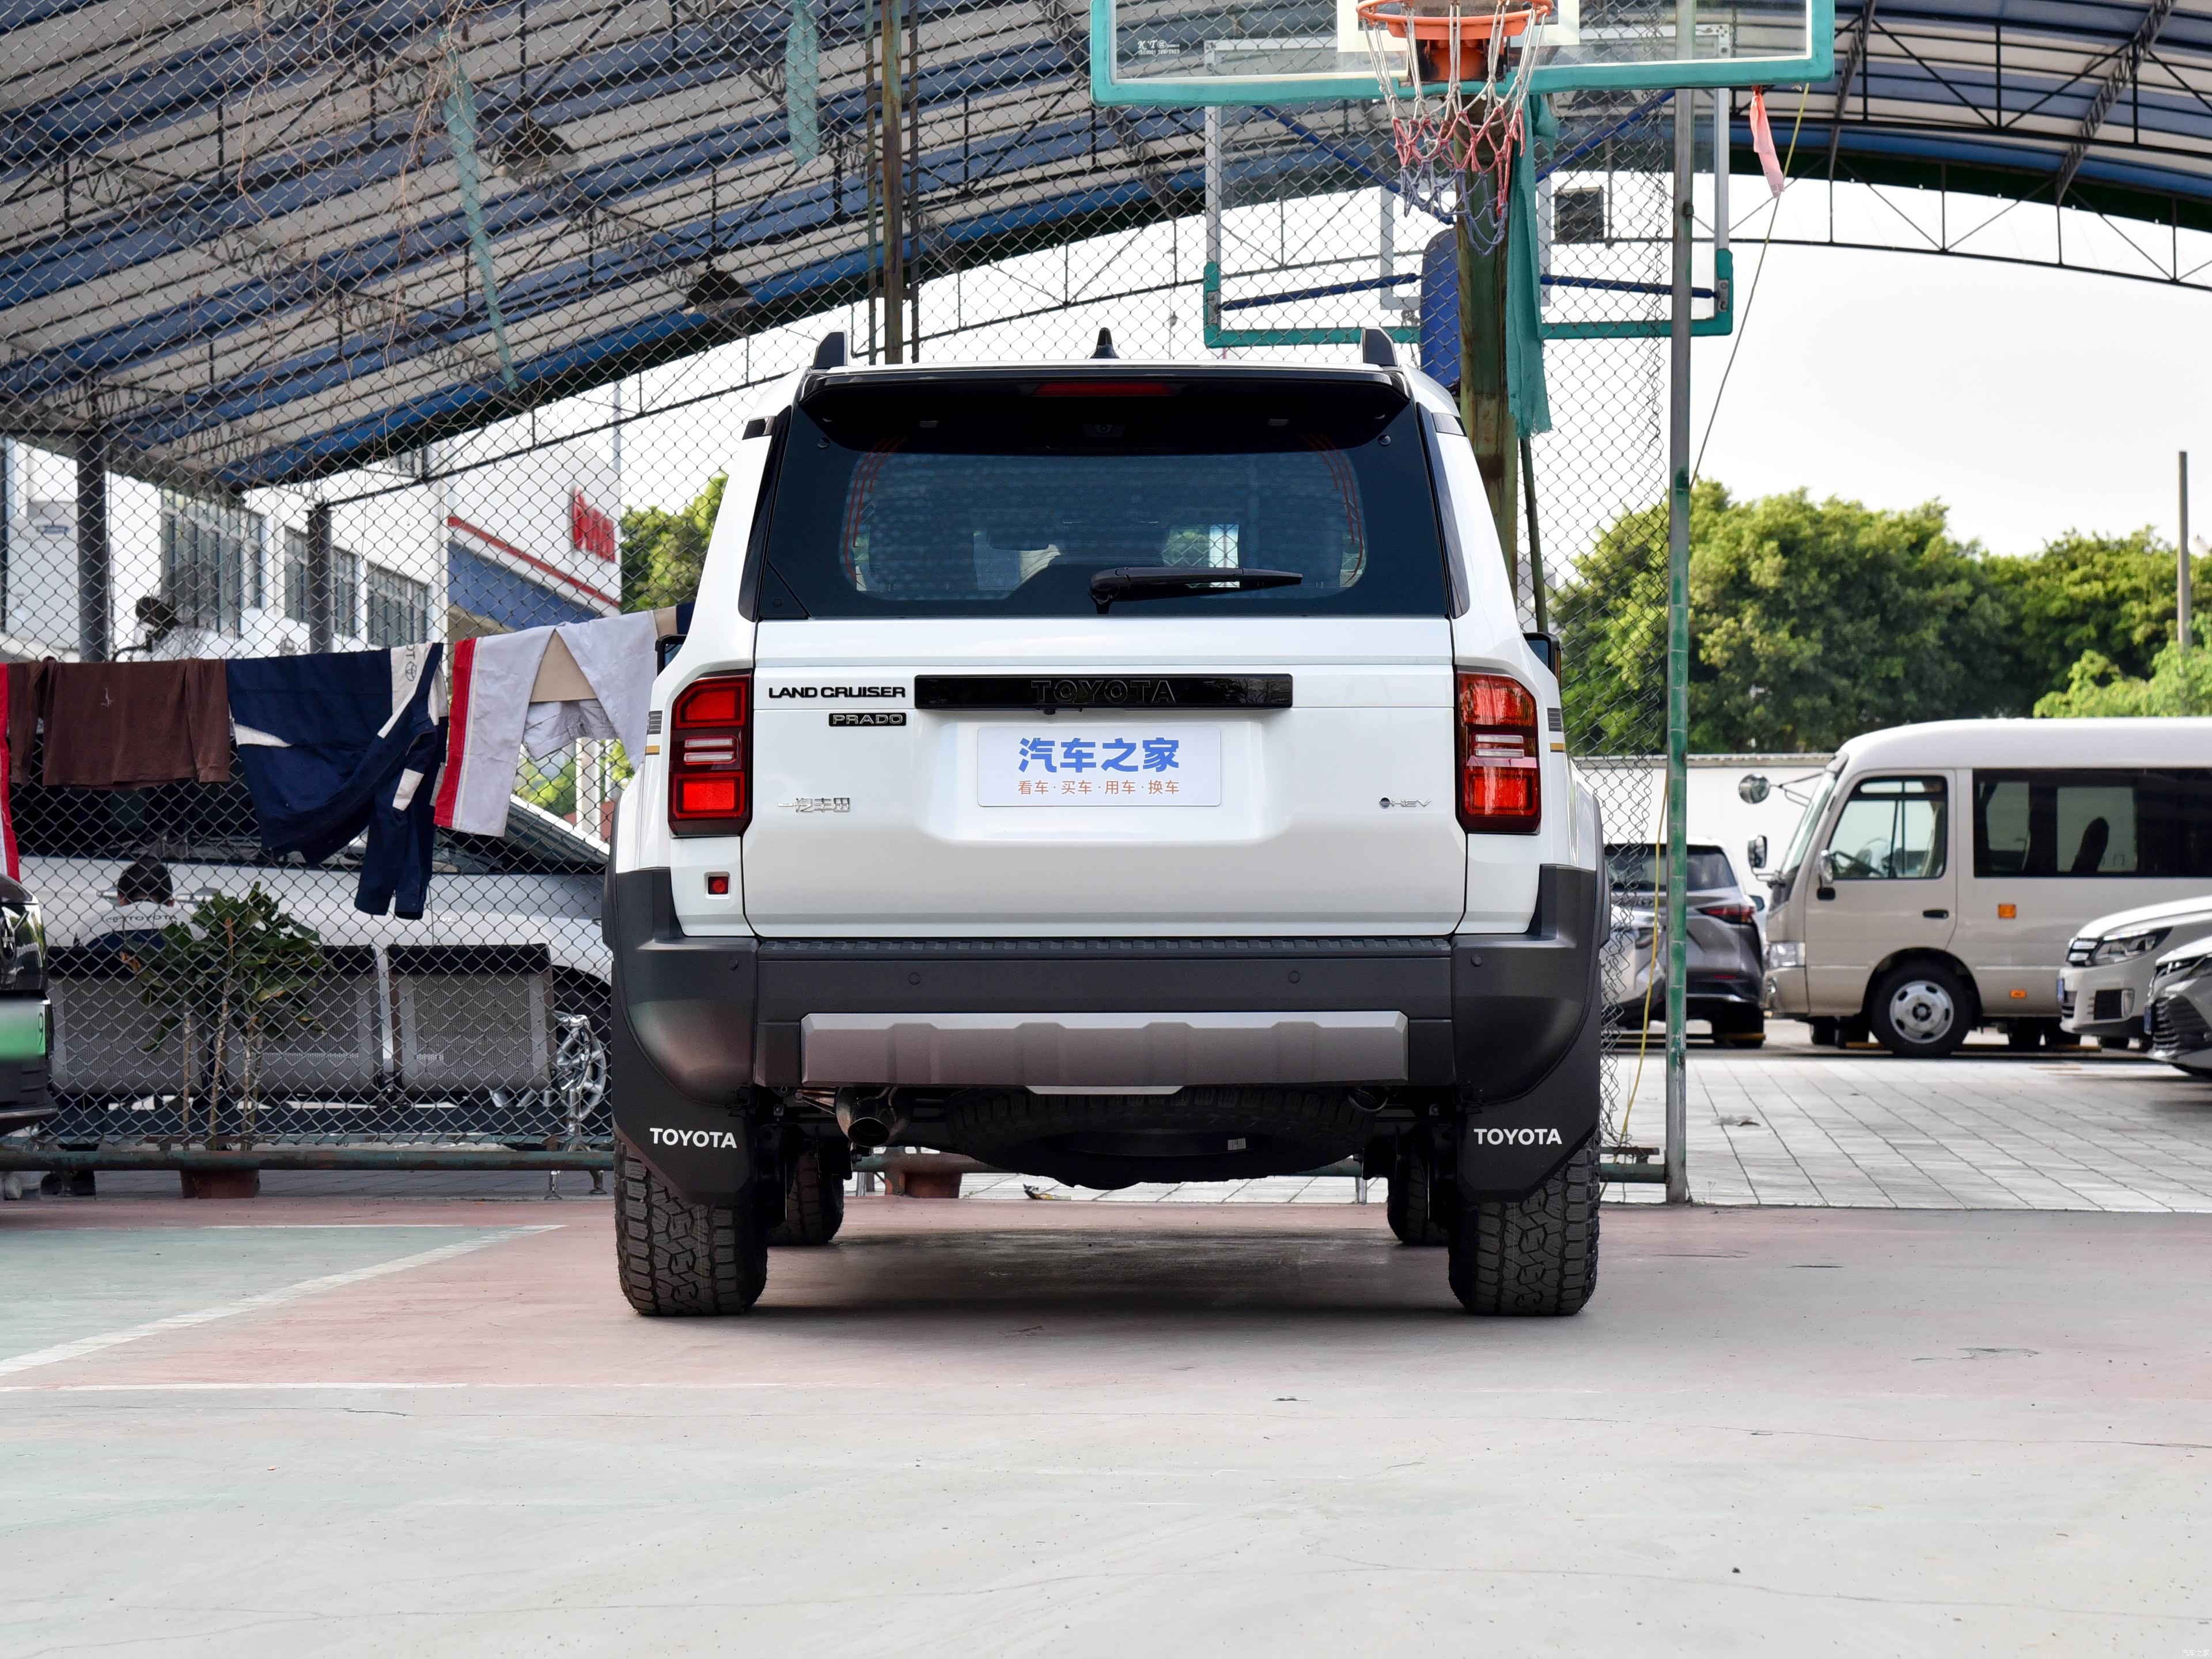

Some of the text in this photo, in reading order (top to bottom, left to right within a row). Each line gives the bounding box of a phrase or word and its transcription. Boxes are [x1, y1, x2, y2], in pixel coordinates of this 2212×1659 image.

[768, 686, 906, 698] LAND CRUISER
[1031, 679, 1176, 704] TOYOTA
[832, 714, 903, 725] PRADO
[1018, 737, 1179, 773] 汽车之家
[649, 1127, 737, 1149] TOYOTA
[1474, 1128, 1563, 1145] TOYOTA
